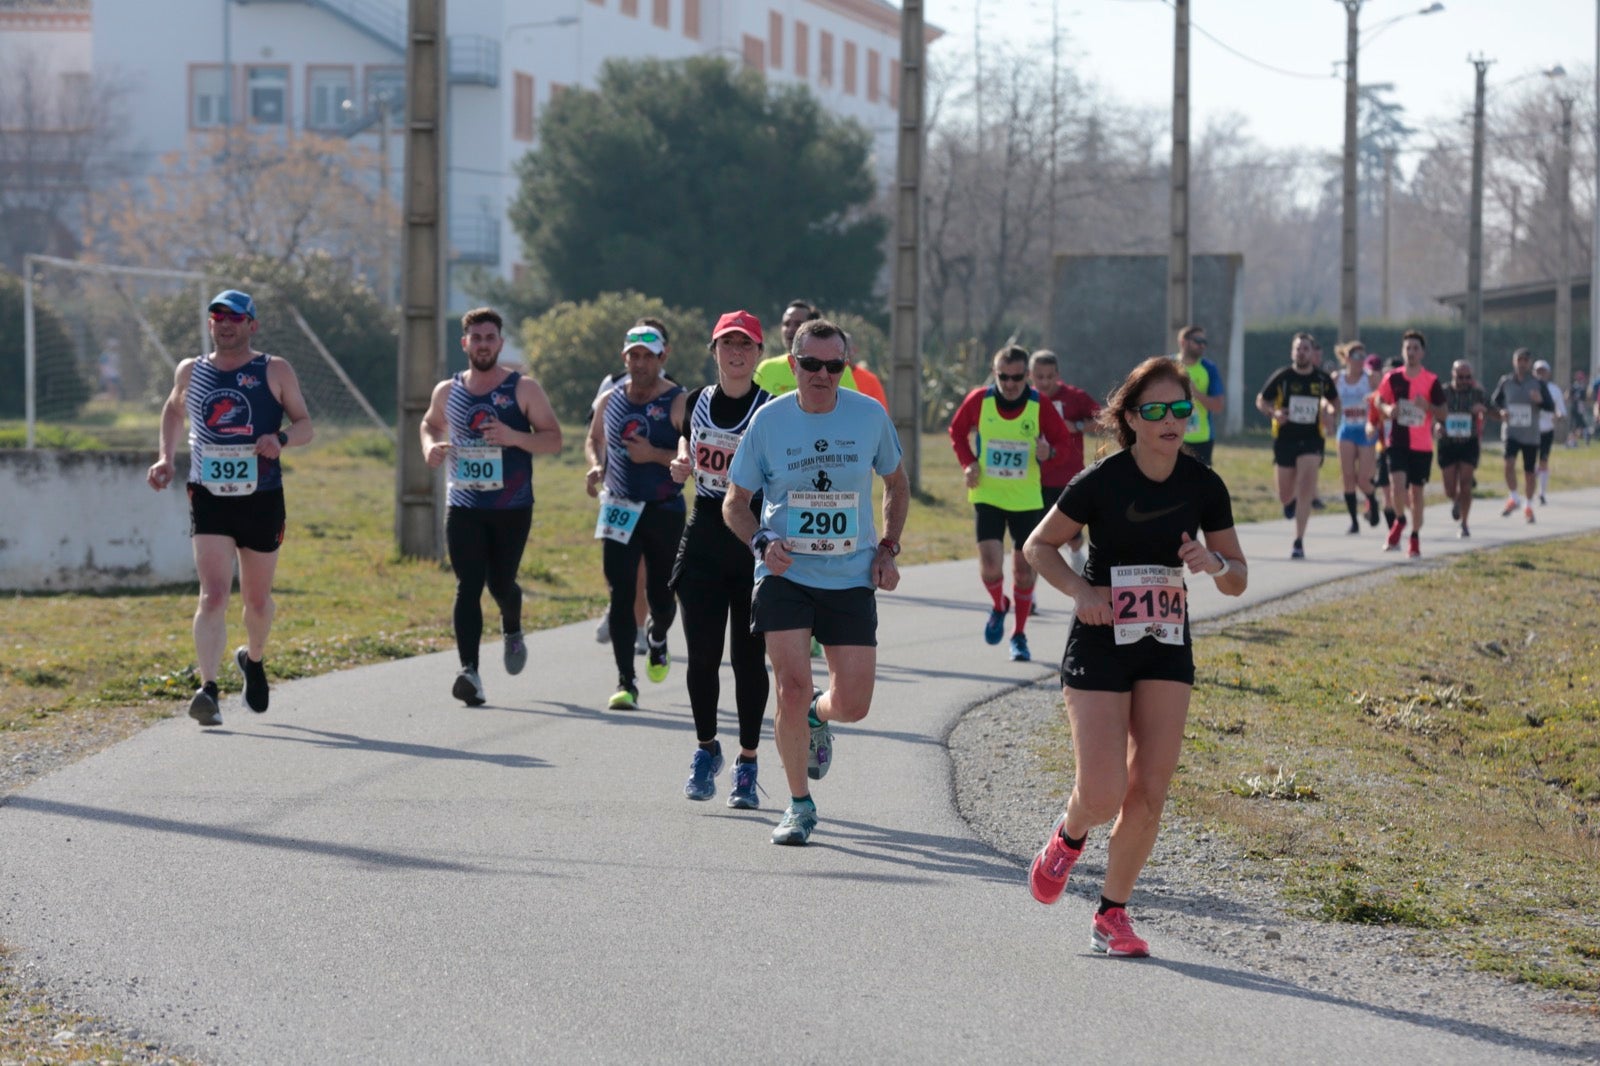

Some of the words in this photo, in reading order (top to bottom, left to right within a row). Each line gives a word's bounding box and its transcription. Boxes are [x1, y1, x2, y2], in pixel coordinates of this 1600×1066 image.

[816, 454, 835, 464] PREMIO
[836, 454, 842, 463] DE
[844, 454, 858, 463] FONDO
[992, 451, 1022, 466] 975
[211, 461, 248, 478] 392
[799, 511, 847, 535] 290
[1119, 590, 1182, 619] 2194
